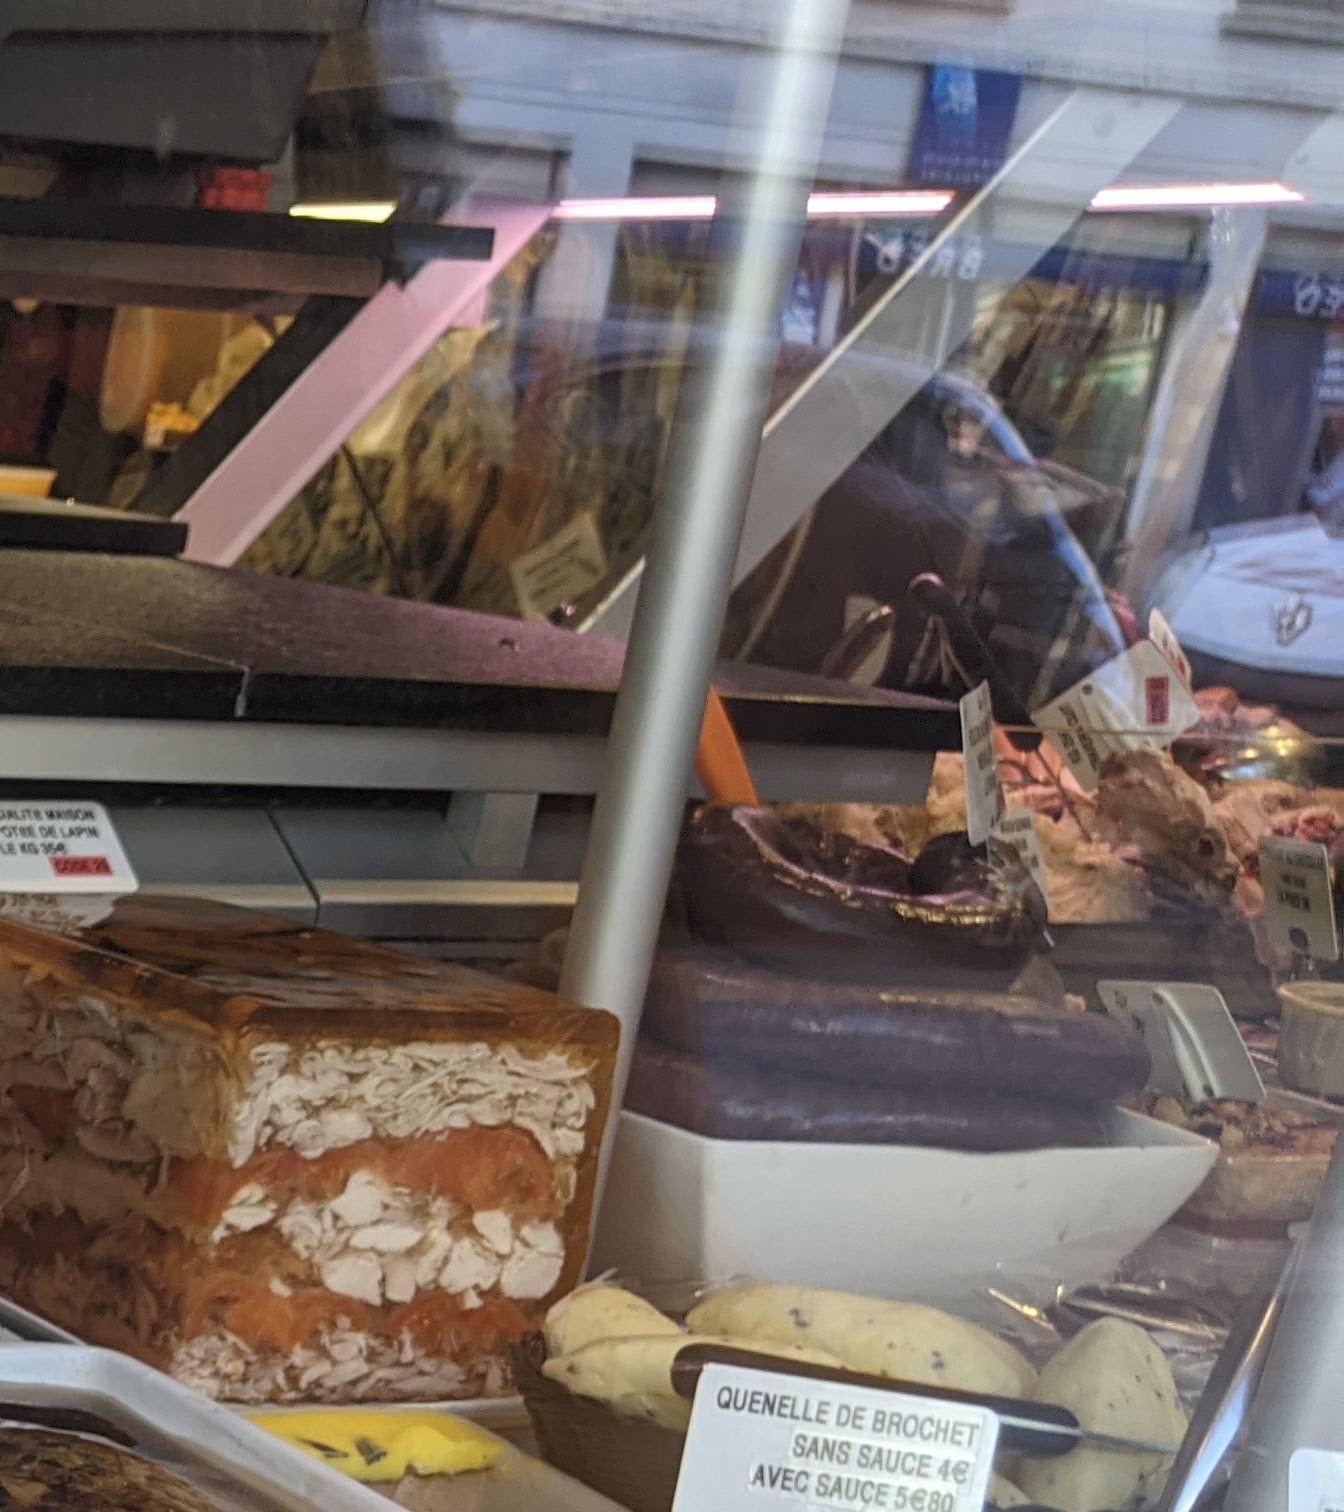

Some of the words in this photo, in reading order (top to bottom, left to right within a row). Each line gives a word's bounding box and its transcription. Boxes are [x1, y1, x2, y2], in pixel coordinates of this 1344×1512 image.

[0, 843, 16, 855] LE
[18, 843, 38, 855] KG
[39, 825, 58, 838] DE
[60, 825, 99, 838] LAPIN
[716, 1385, 830, 1426] QUENELLE
[836, 1403, 866, 1430] DE
[871, 1410, 981, 1447] BROCHET
[792, 1433, 852, 1466] SANS
[856, 1443, 932, 1479] SAUCE
[936, 1458, 970, 1485] 4€
[750, 1463, 810, 1493] AVEC
[815, 1476, 891, 1508] SAUCE
